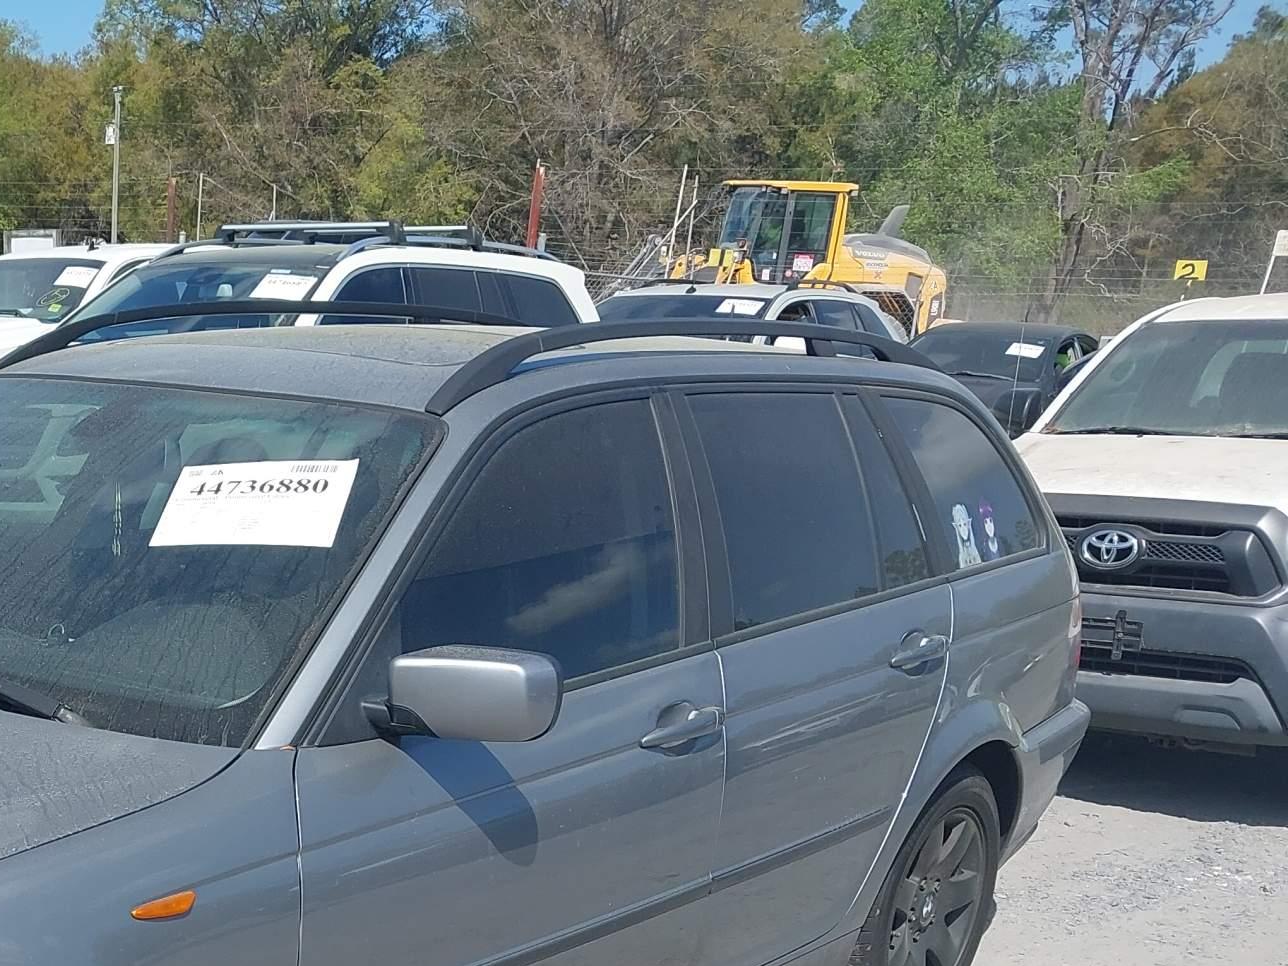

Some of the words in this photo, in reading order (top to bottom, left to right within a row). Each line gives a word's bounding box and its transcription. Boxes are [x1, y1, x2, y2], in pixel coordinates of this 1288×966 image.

[855, 249, 886, 258] VOLVO
[1178, 263, 1199, 280] 2
[190, 478, 329, 495] 44736880
